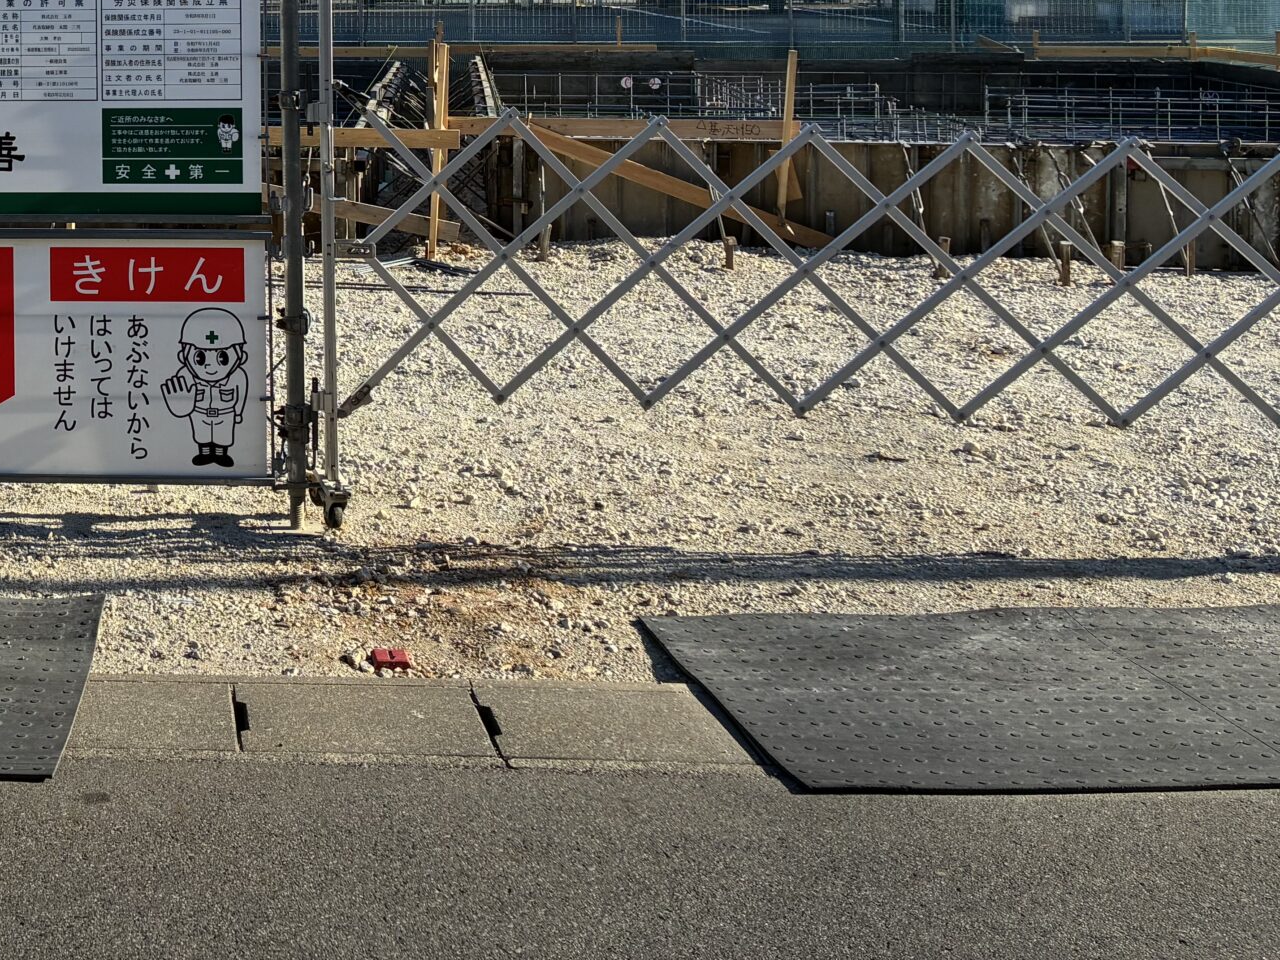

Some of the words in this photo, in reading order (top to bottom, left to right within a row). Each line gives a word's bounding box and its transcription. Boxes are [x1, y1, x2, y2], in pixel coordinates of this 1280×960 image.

[104, 28, 162, 36] 保険関係成立番号
[105, 44, 162, 52] 事業の期間
[105, 74, 162, 82] 注文者の氏名
[115, 164, 157, 180] 安全
[188, 164, 230, 180] 第一
[72, 254, 223, 296] きけん
[53, 315, 78, 432] いけません
[89, 314, 114, 420] はいっては
[126, 314, 150, 461] あぶないから
